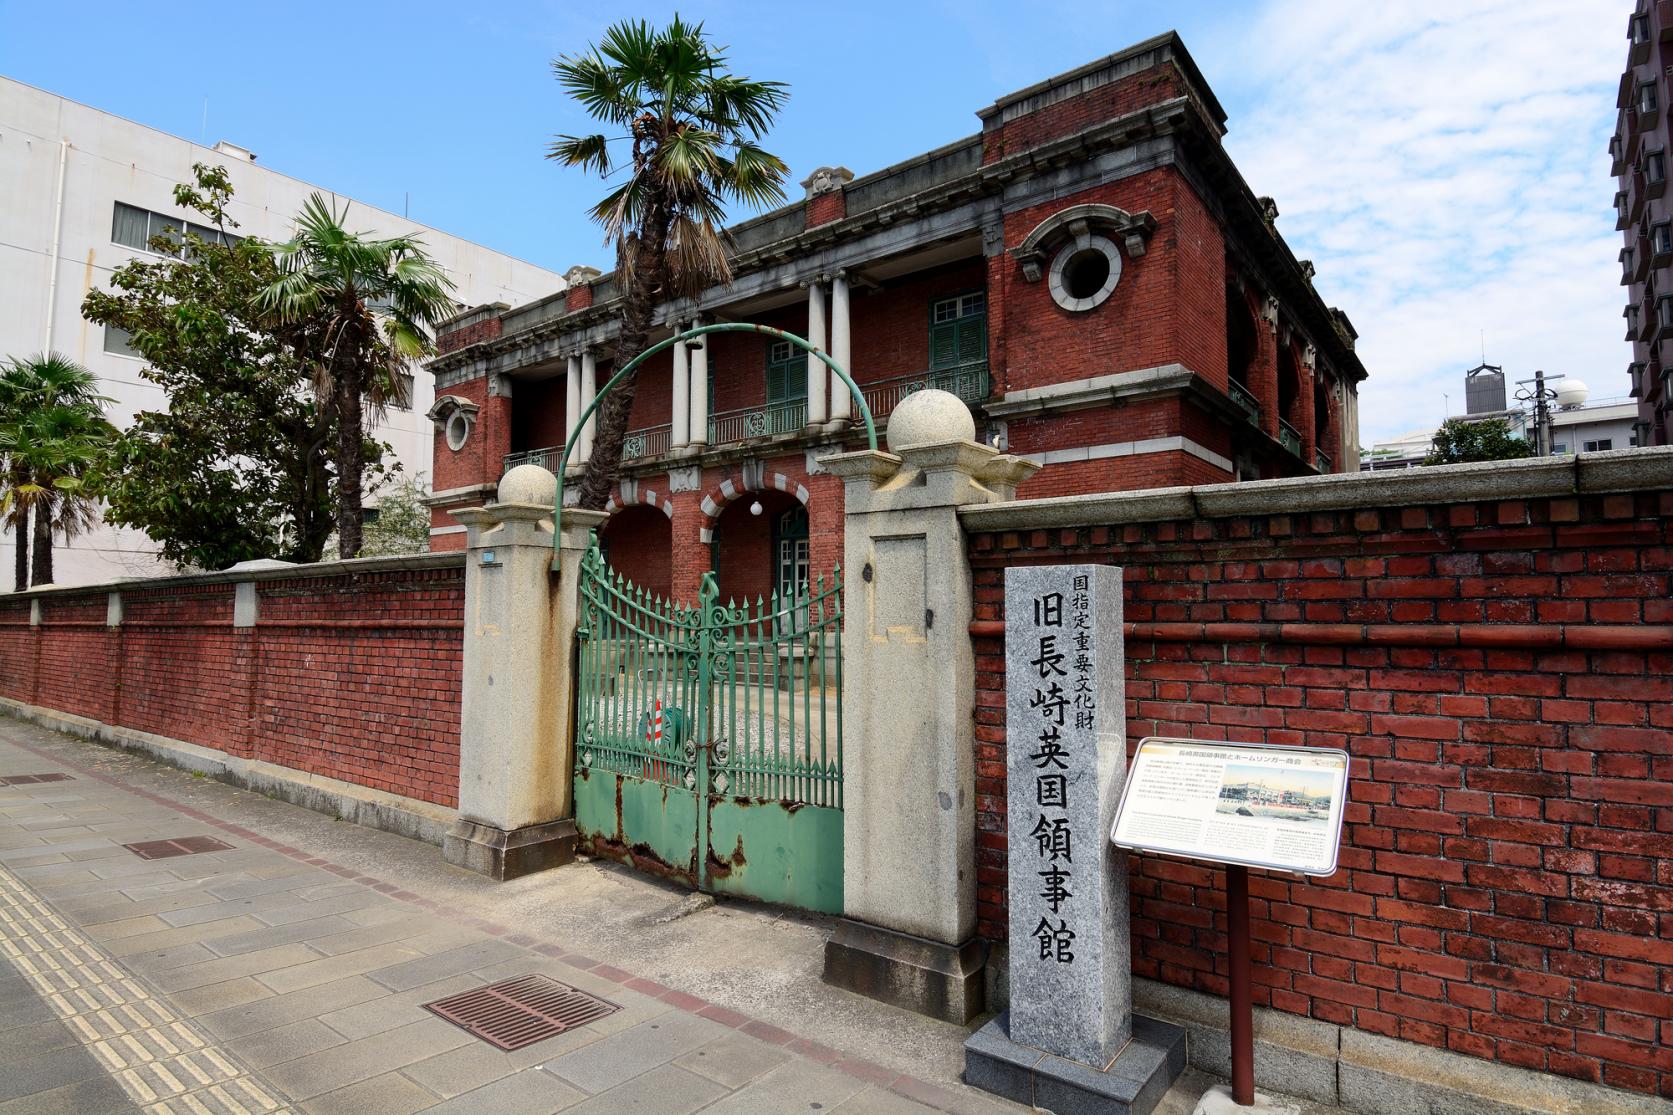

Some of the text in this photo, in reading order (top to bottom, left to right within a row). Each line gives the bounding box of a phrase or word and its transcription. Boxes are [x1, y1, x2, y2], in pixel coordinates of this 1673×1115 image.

[1029, 592, 1076, 963] 旧長崎英国領事館
[1072, 575, 1095, 730] 国指定重要文化財
